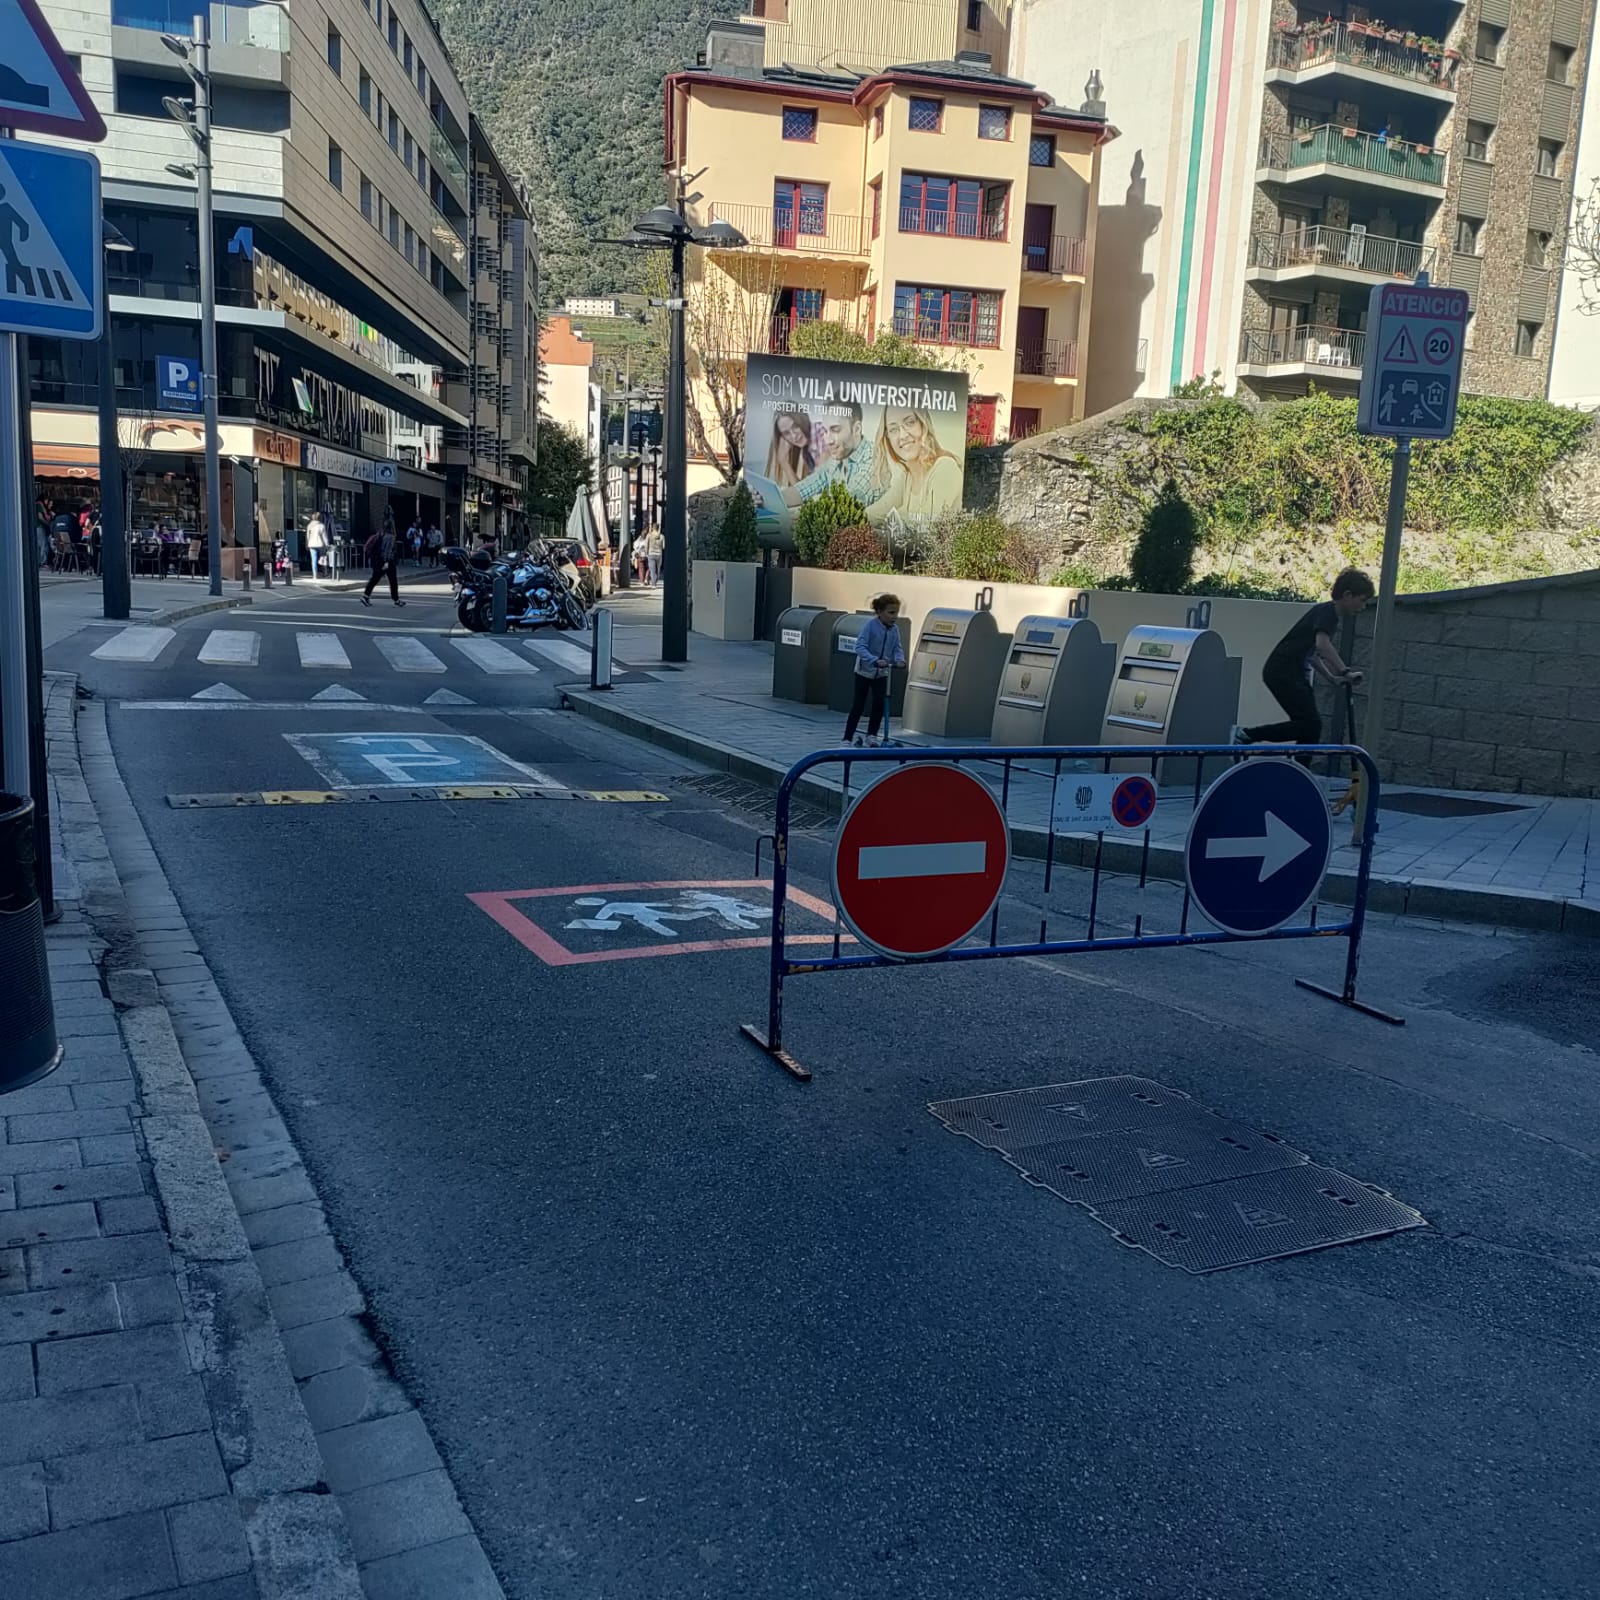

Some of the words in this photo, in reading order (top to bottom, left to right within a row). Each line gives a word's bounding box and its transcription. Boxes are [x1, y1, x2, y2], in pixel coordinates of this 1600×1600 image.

[1383, 292, 1463, 317] ATENCIÓ
[1429, 338, 1449, 354] 20
[168, 361, 189, 388] P
[761, 373, 793, 397] SOM
[798, 377, 834, 401] VILA
[839, 381, 957, 412] UNIVERSITÀRIA
[798, 403, 810, 414] PEL
[828, 406, 853, 417] FUTUR
